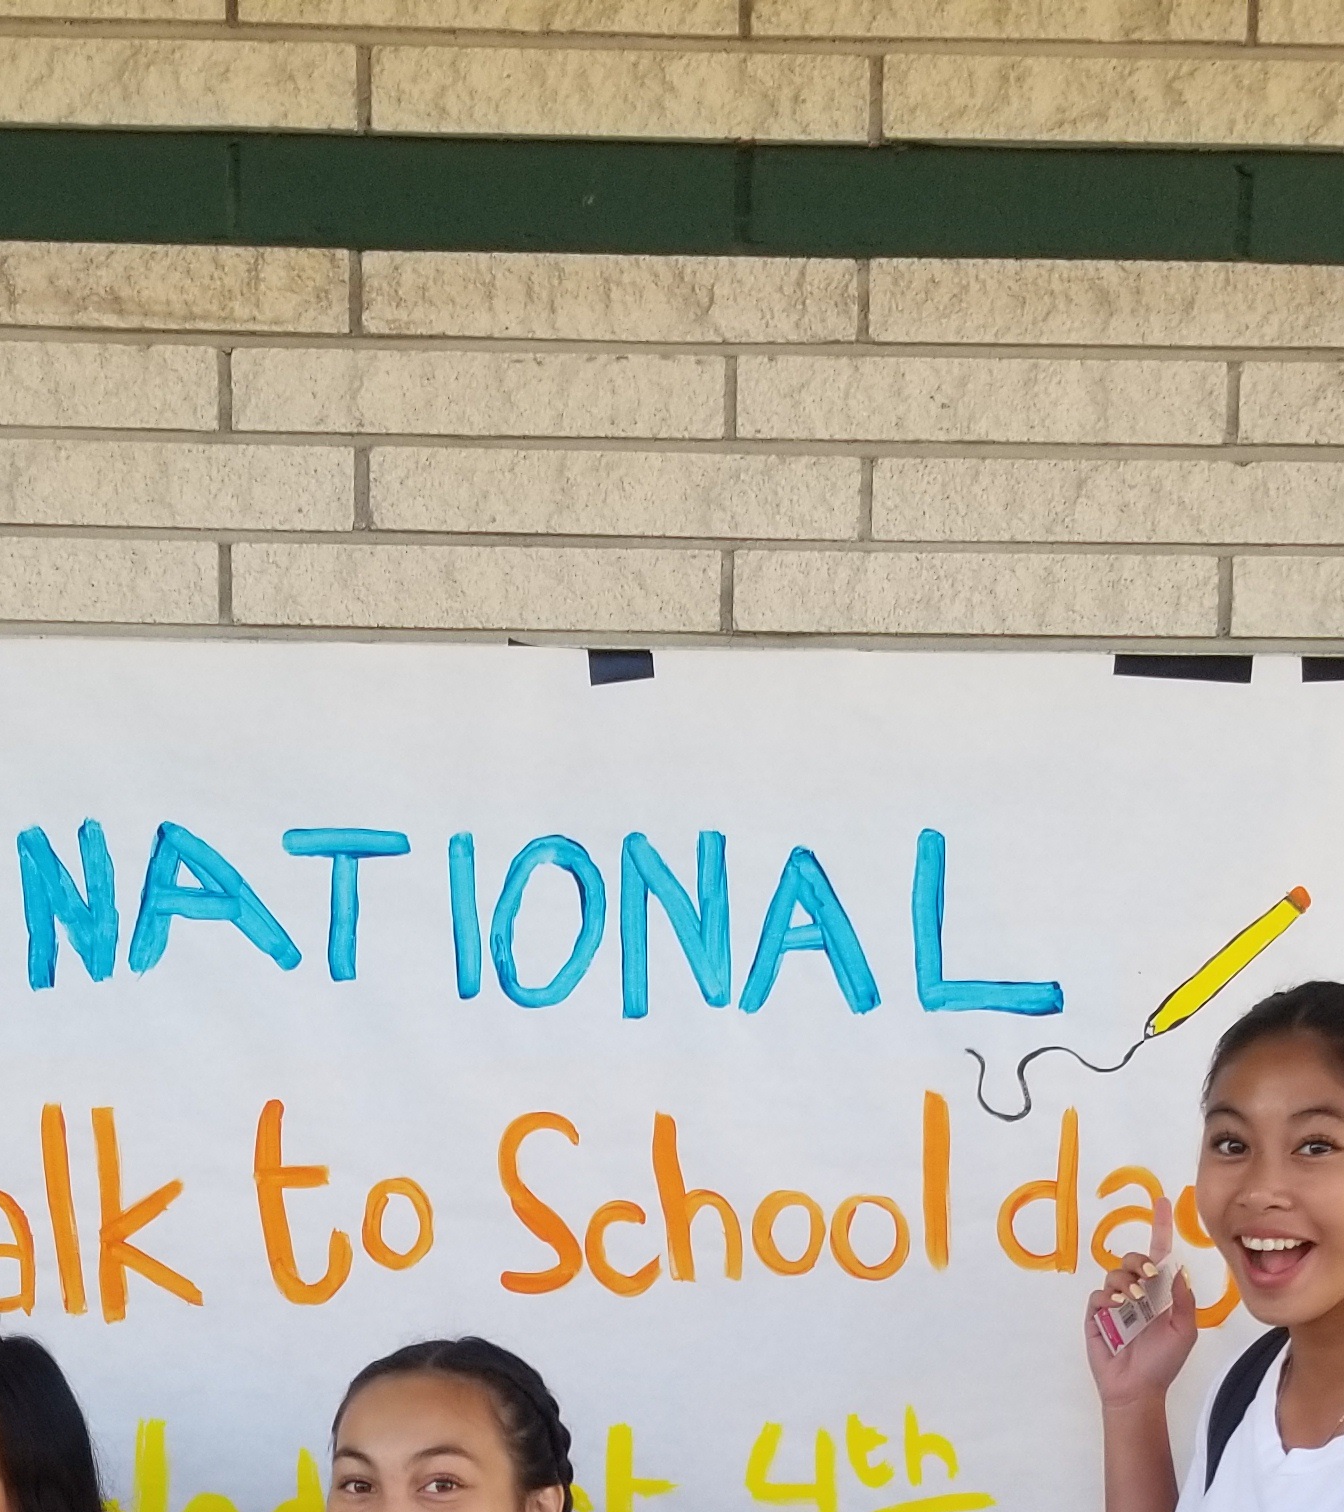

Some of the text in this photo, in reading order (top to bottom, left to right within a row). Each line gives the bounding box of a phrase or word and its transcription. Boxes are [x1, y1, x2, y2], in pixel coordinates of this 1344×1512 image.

[17, 818, 1066, 1019] NATIONAL
[254, 1099, 434, 1305] to
[498, 1090, 950, 1298] School
